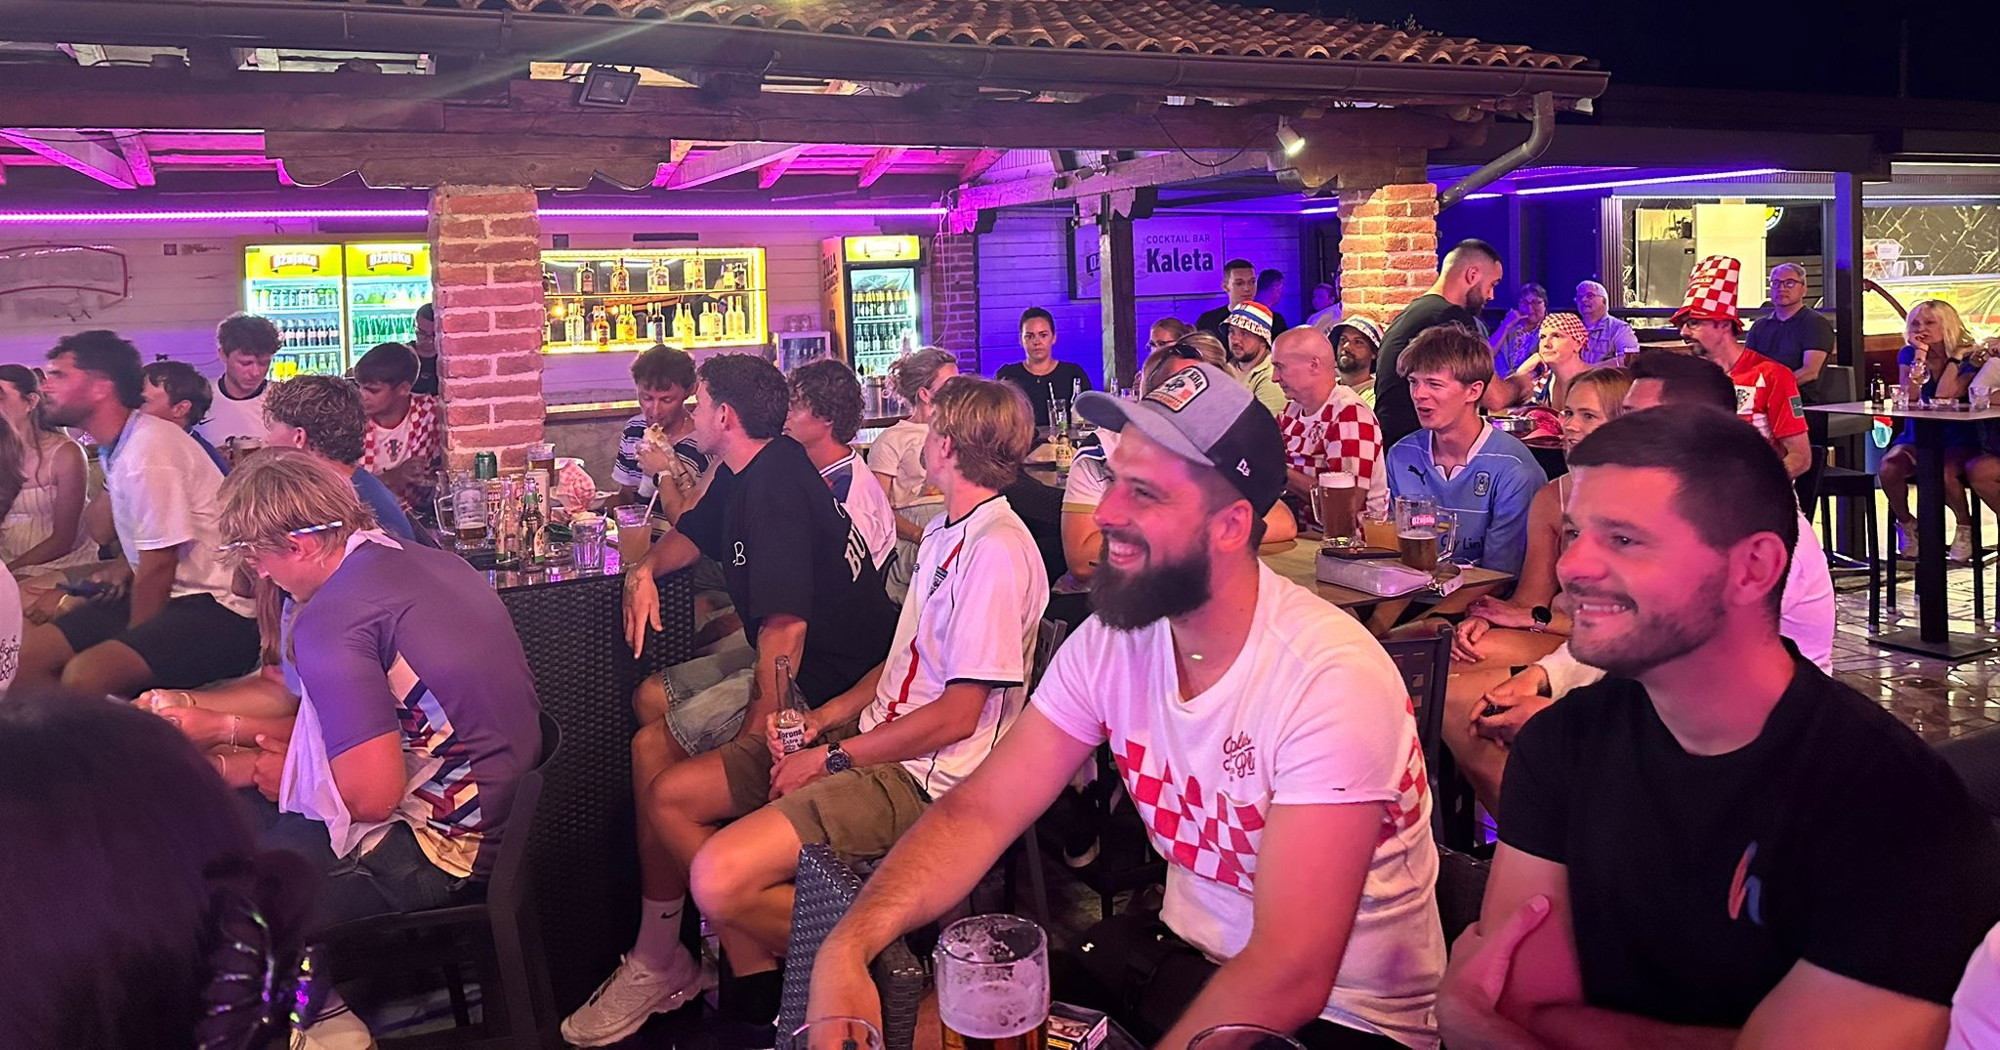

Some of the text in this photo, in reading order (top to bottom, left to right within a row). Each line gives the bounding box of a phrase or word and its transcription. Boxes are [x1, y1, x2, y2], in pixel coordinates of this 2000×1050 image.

[1146, 234, 1211, 245] COCKTAIL BAR
[1146, 247, 1214, 273] Kaleta
